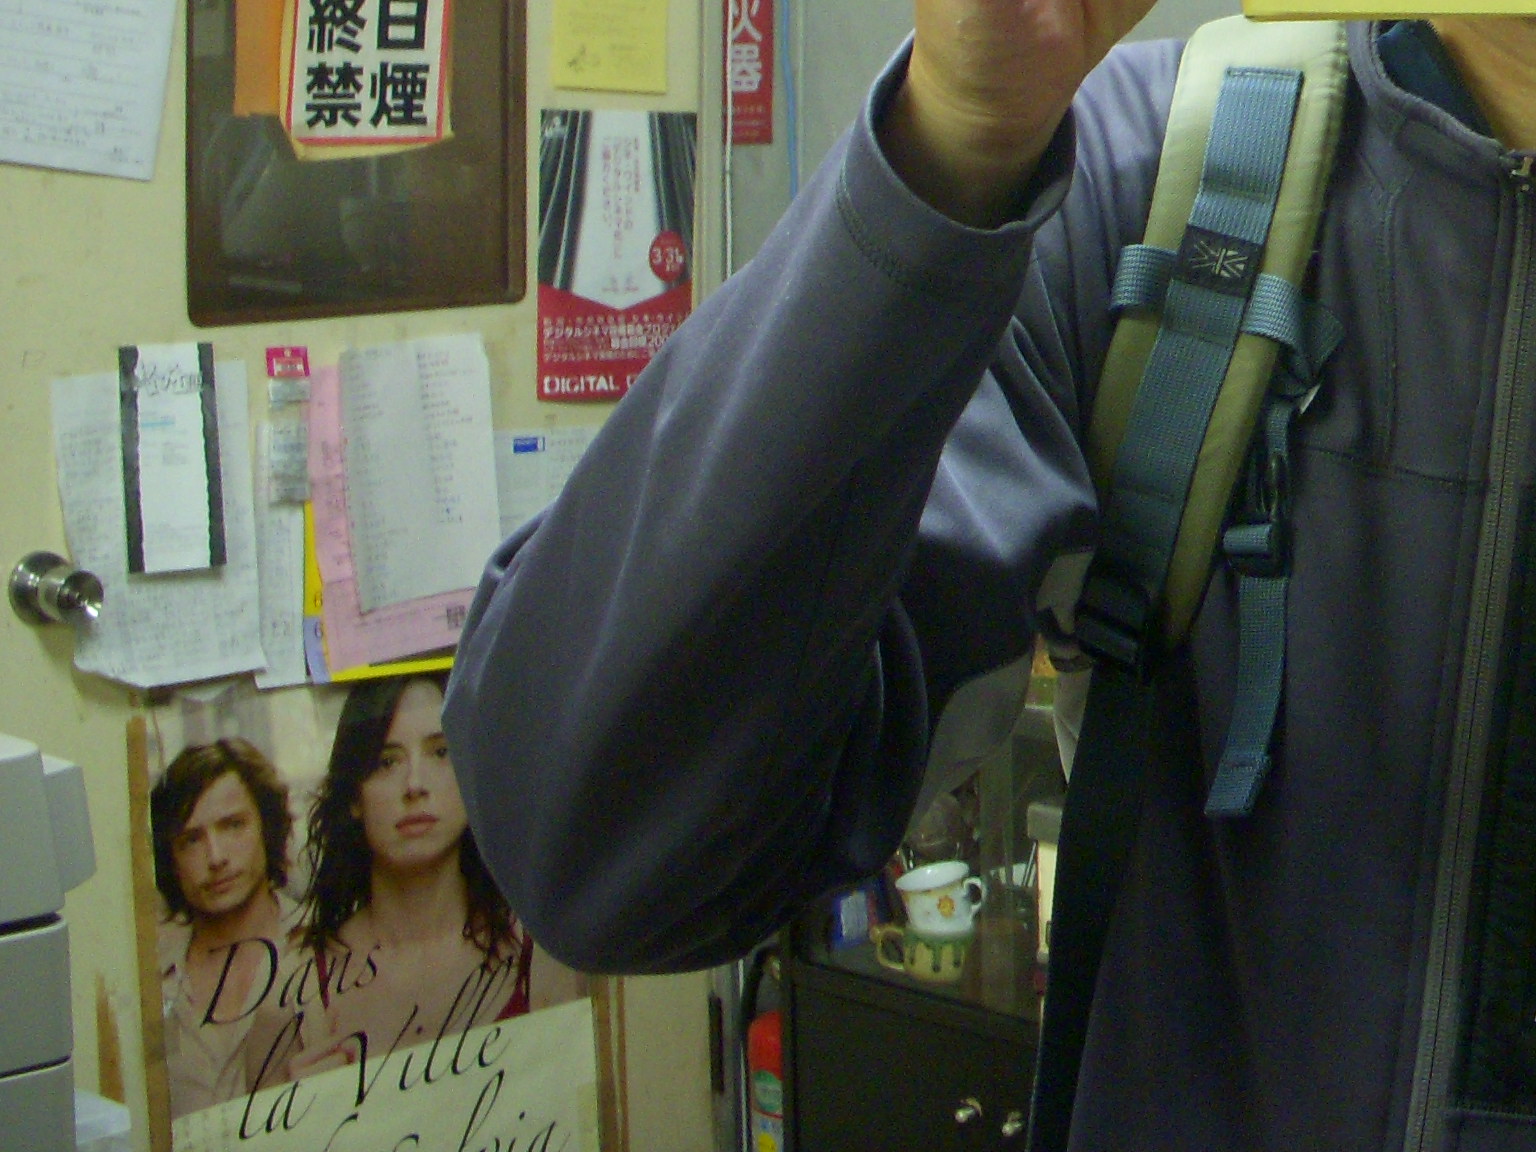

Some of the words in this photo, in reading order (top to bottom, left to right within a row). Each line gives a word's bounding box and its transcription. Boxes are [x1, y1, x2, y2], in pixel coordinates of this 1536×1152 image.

[304, 60, 431, 129] 禁煙
[543, 375, 620, 395] DIGITAL
[200, 936, 381, 1027] Dans
[238, 1010, 316, 1140] la
[350, 955, 510, 1108] Ville
